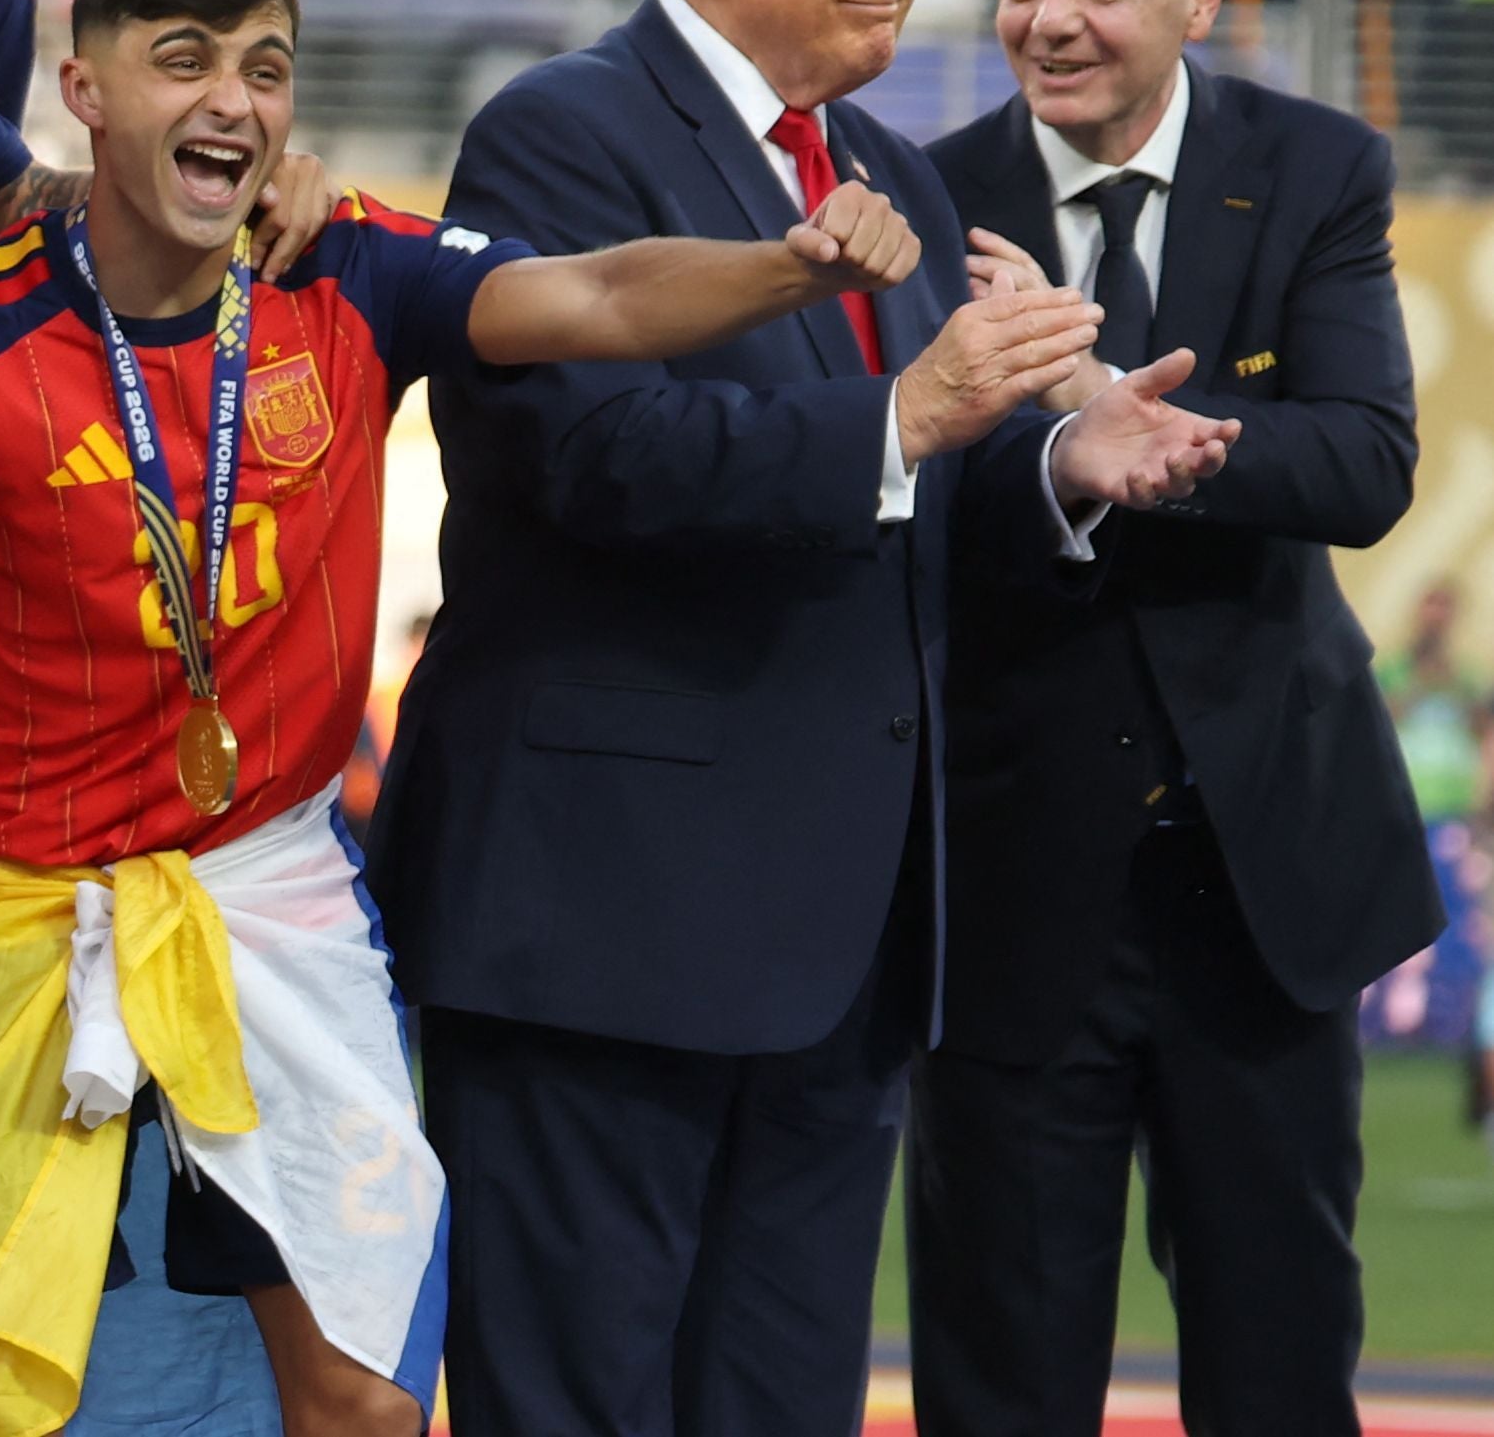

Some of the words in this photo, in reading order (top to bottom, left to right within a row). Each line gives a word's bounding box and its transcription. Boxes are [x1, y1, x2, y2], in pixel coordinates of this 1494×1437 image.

[114, 346, 138, 389] CUP
[1234, 350, 1277, 378] FIFA
[218, 380, 237, 425] FIFA
[123, 389, 157, 464] 2026
[214, 426, 234, 505] WORLD
[211, 505, 229, 548] CUP
